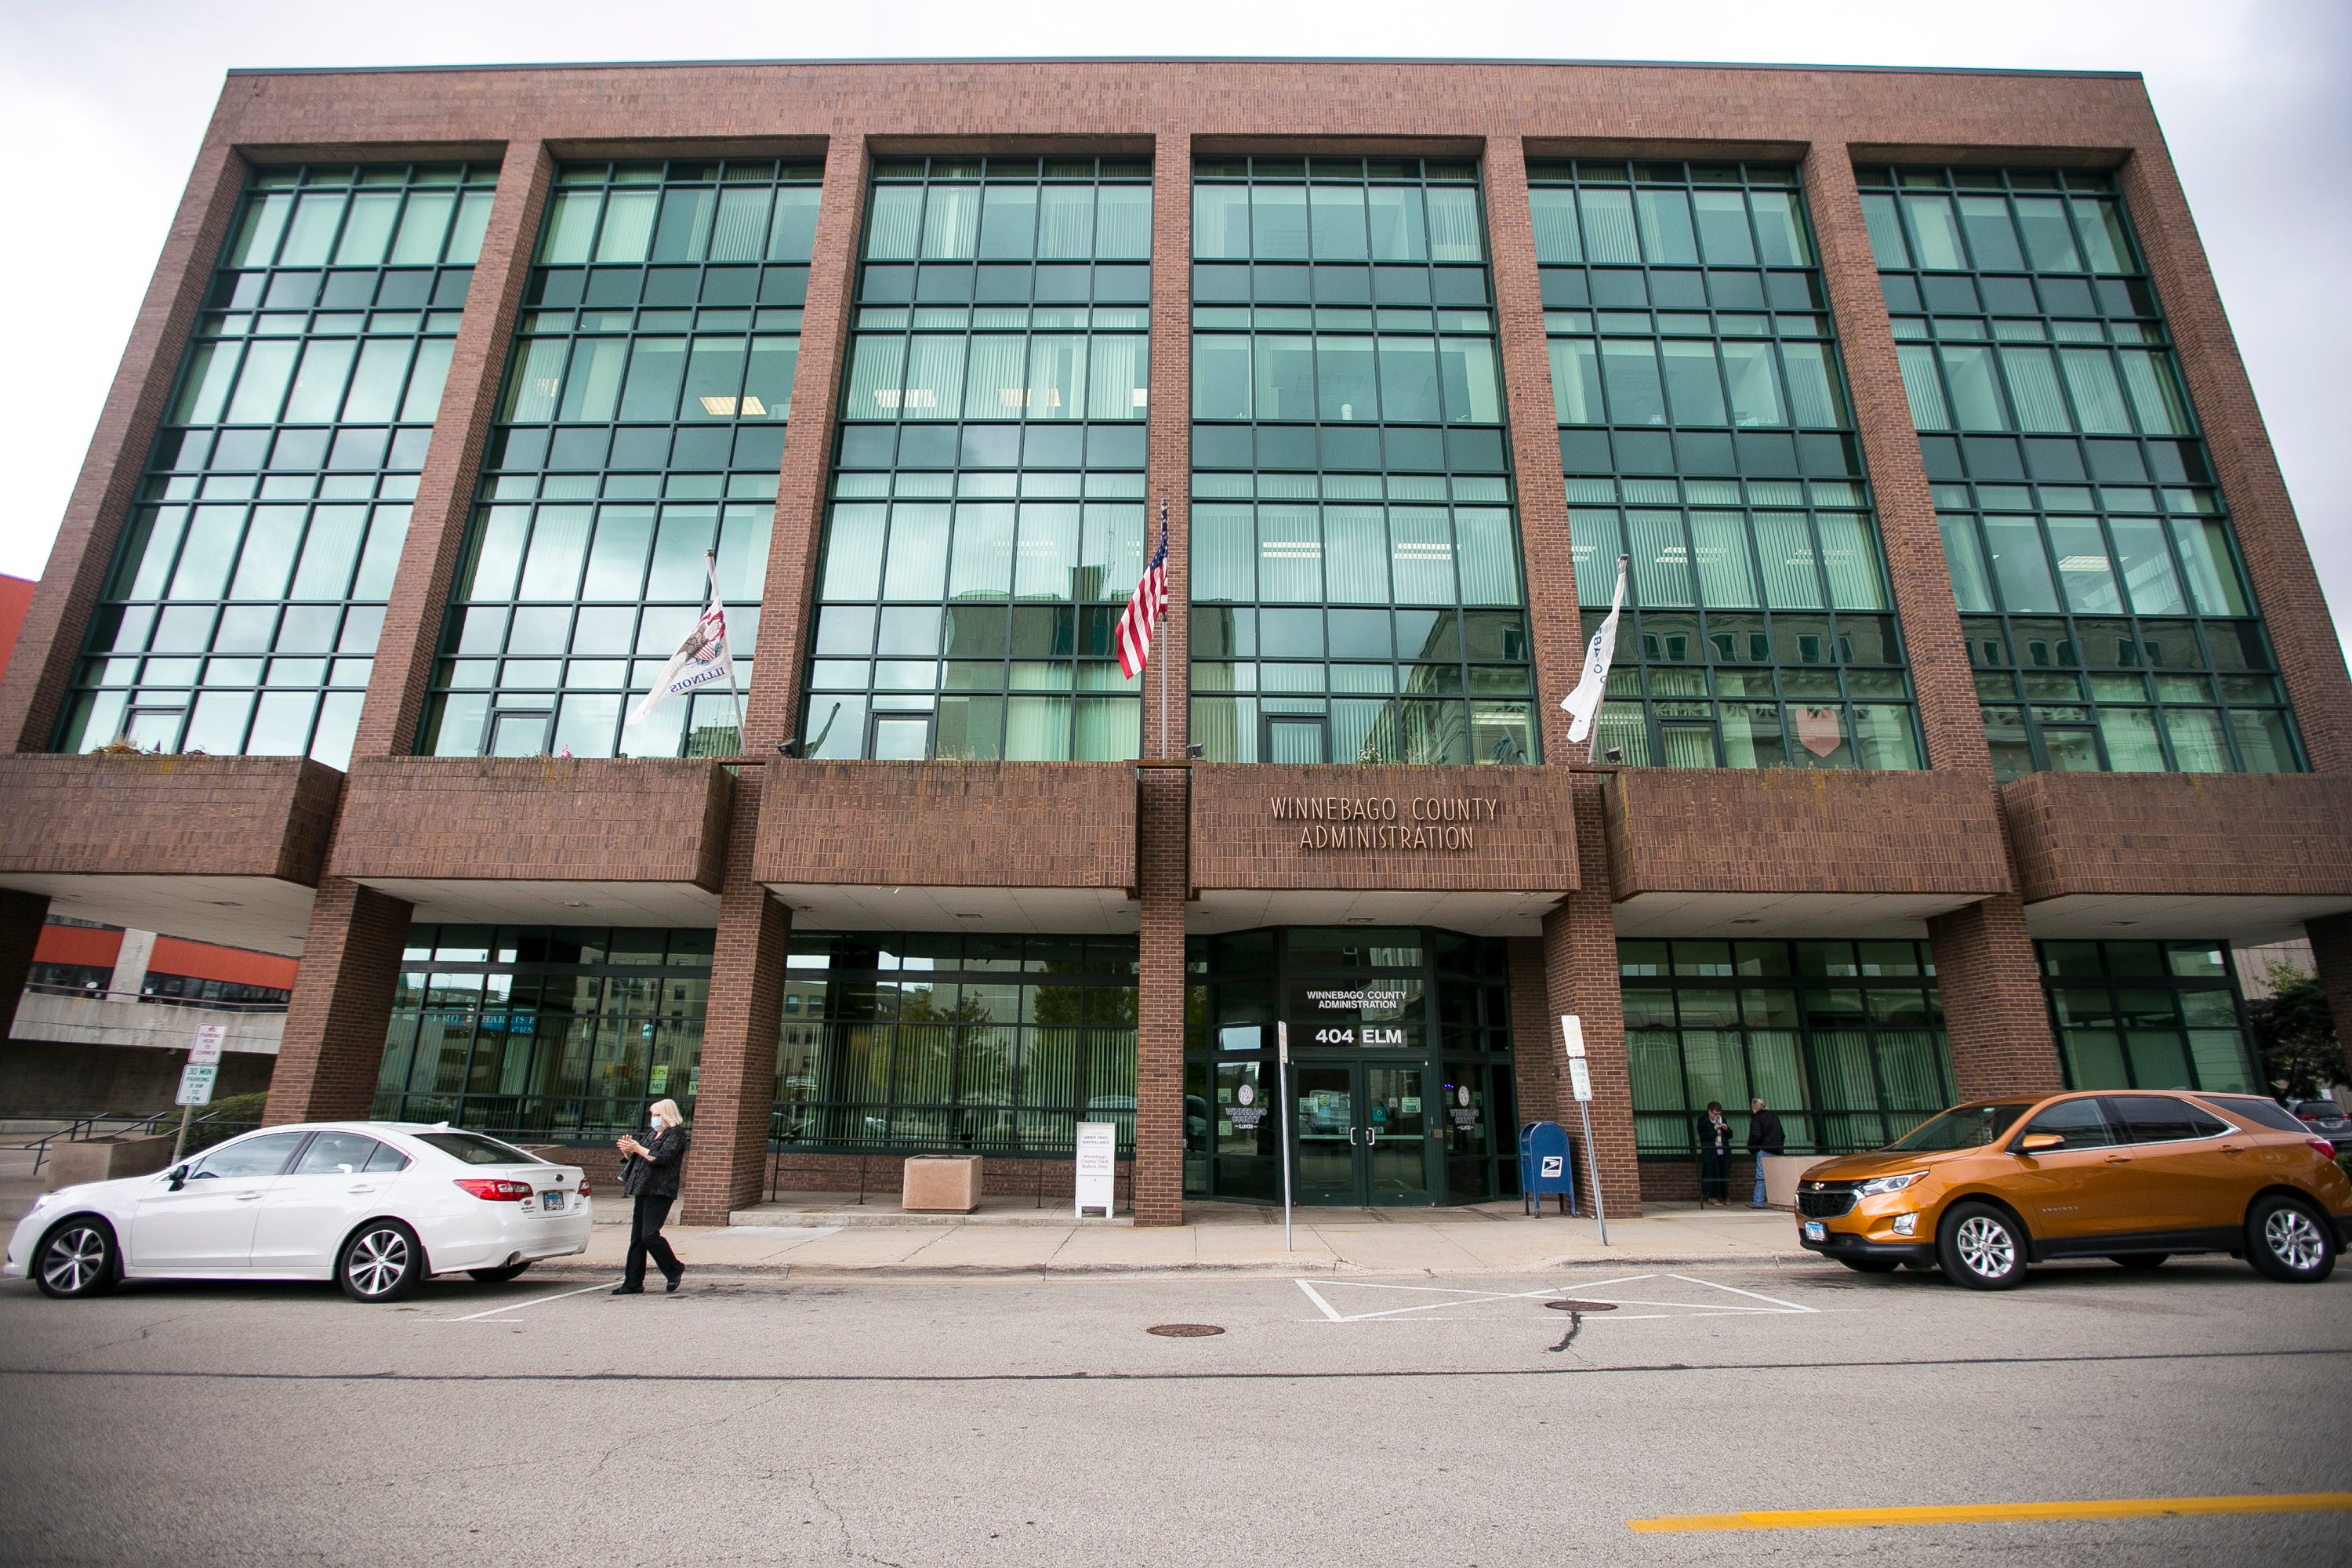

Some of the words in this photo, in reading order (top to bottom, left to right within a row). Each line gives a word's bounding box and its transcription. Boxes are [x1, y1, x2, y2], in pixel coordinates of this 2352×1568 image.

[1271, 797, 1396, 821] WINNEBAGO
[1412, 797, 1497, 821] COUNTY
[1300, 826, 1474, 850] ADMINISTRATION
[1316, 1029, 1354, 1044] 404
[1363, 1029, 1402, 1044] ELM
[1225, 1107, 1268, 1116] WINNEBAGO
[1232, 1115, 1260, 1123] COUNTY
